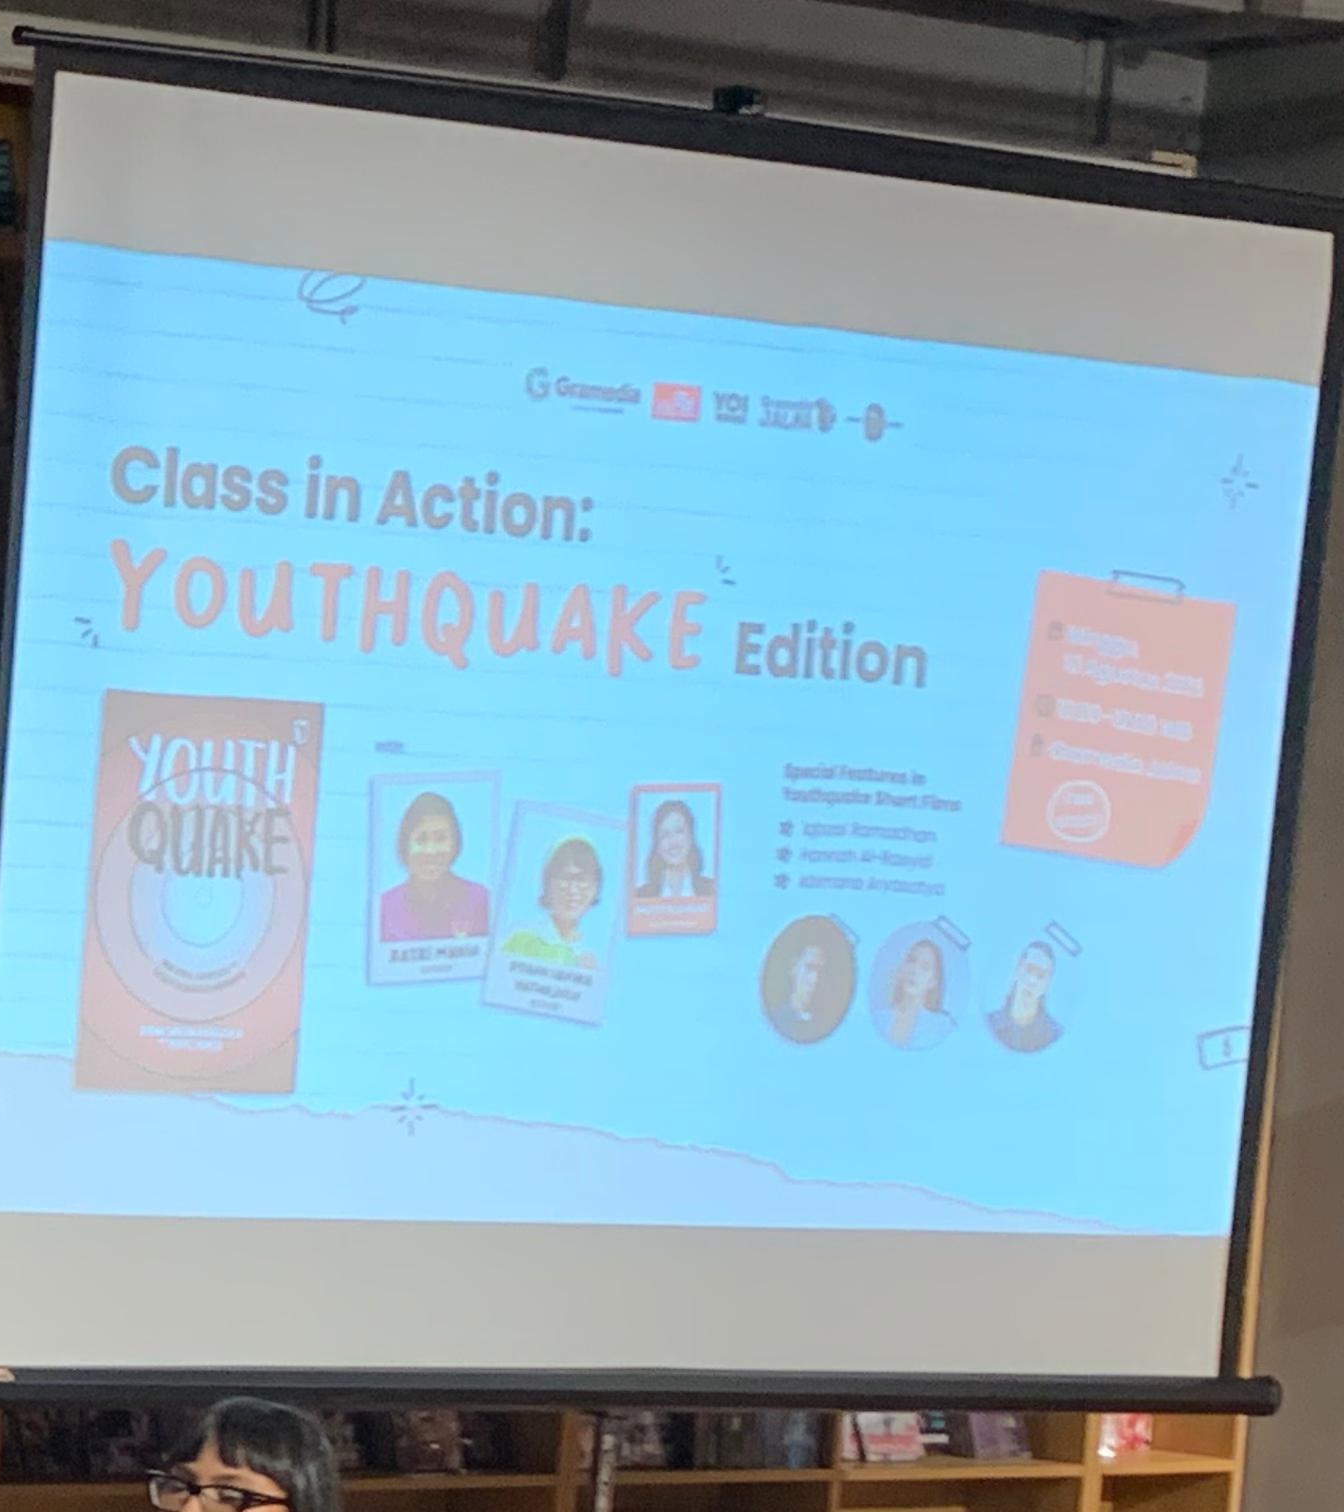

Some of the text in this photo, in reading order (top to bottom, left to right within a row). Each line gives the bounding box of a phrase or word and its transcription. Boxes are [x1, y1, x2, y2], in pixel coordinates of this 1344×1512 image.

[112, 447, 595, 543] Class in Action:
[111, 538, 928, 689] YOUTHQUAKE Edition
[127, 733, 297, 808] YOUTH
[128, 801, 293, 880] QUAKE
